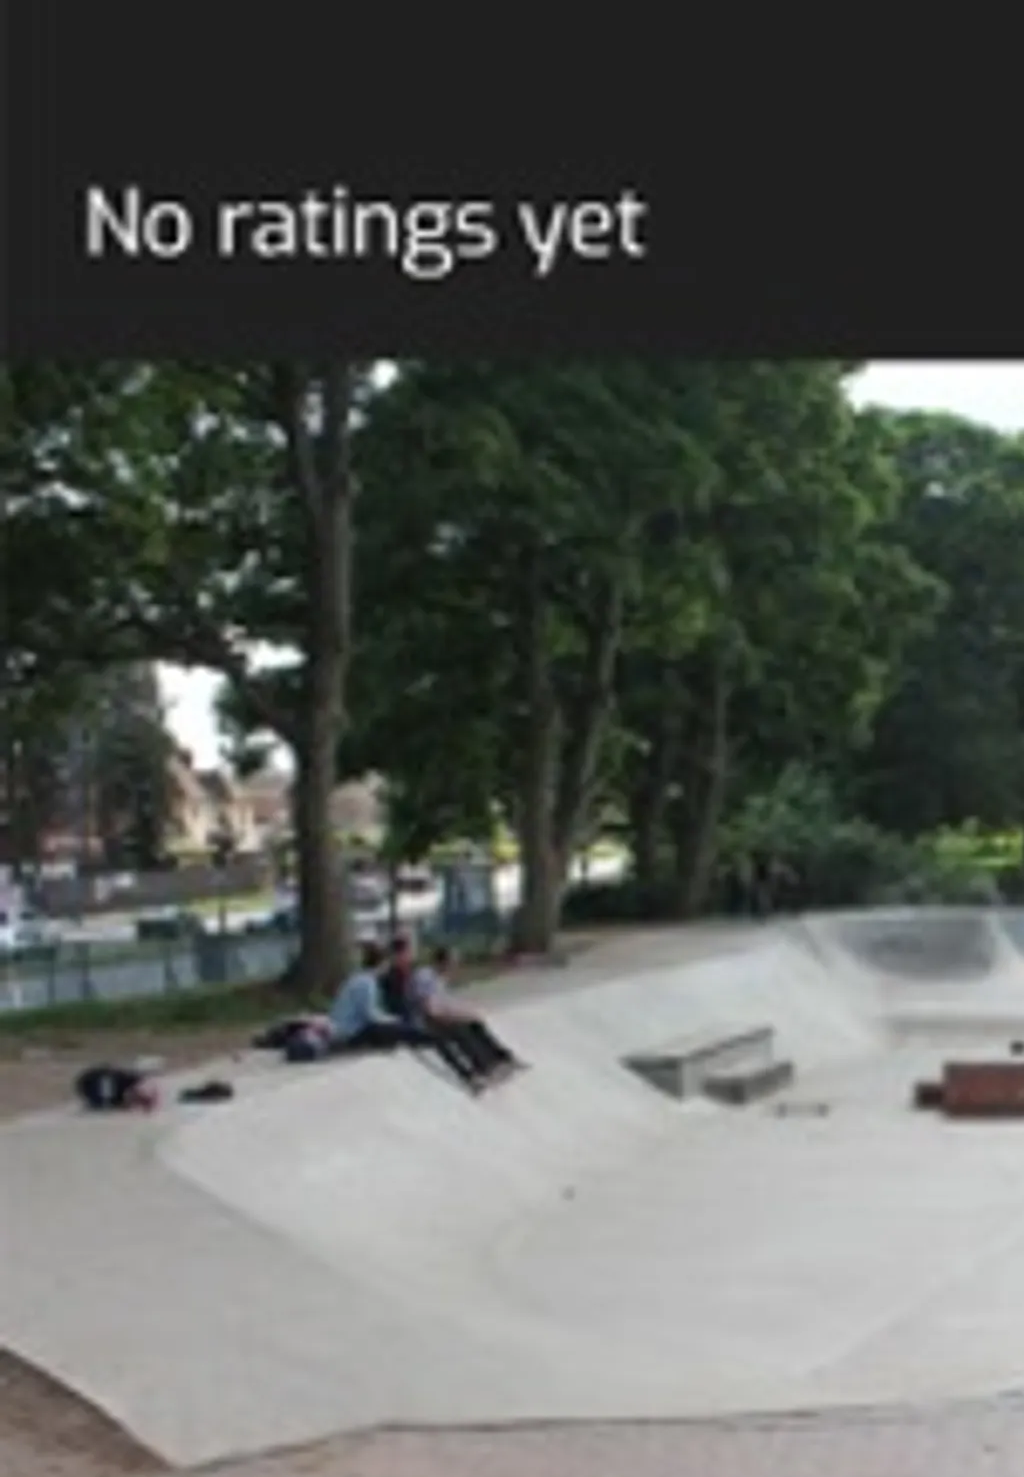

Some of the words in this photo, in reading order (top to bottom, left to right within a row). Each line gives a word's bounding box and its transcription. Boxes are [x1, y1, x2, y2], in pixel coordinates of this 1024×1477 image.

[88, 188, 192, 257] No
[220, 187, 496, 278] ratings
[519, 195, 644, 274] yet
